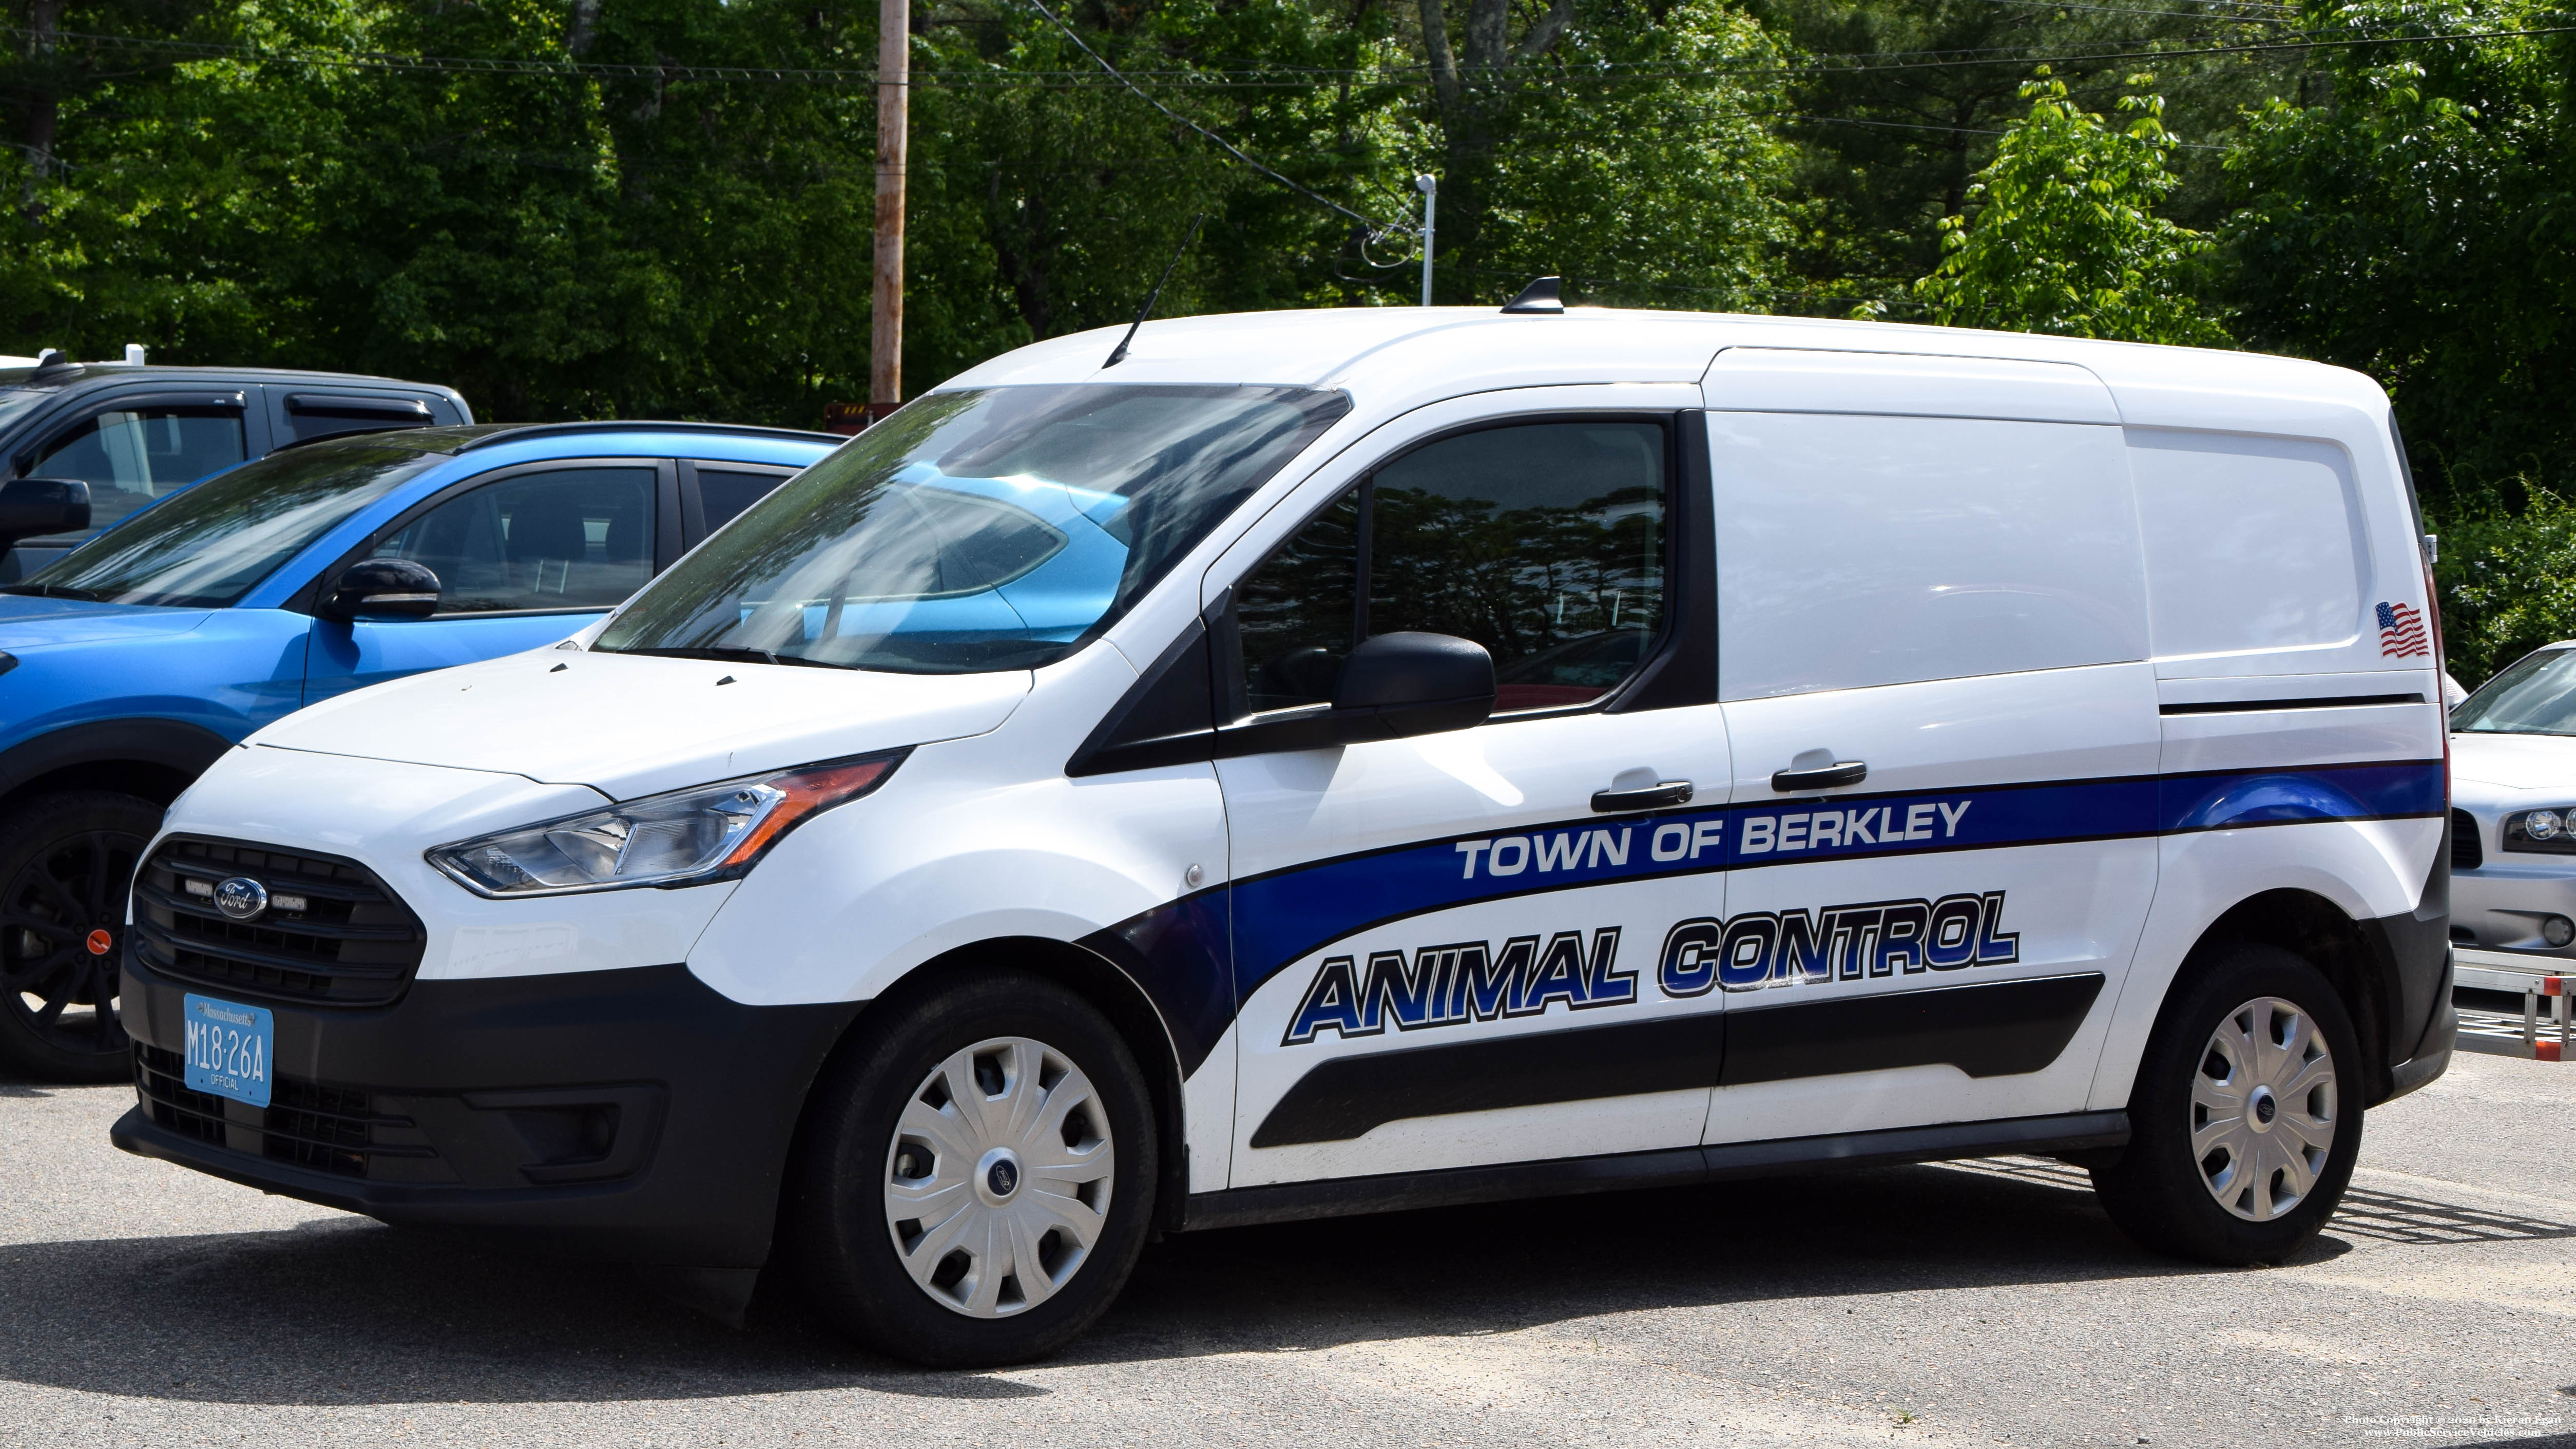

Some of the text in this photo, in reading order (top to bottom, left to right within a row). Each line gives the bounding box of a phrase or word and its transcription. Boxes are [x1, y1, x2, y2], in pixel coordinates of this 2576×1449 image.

[1455, 800, 1972, 879] TOWN OF BERKLEY
[221, 883, 251, 909] Ford
[1280, 890, 2020, 1047] ANIMAL CONTROL
[203, 1002, 252, 1026] Massachusetts
[211, 1074, 239, 1091] OFFICIAL
